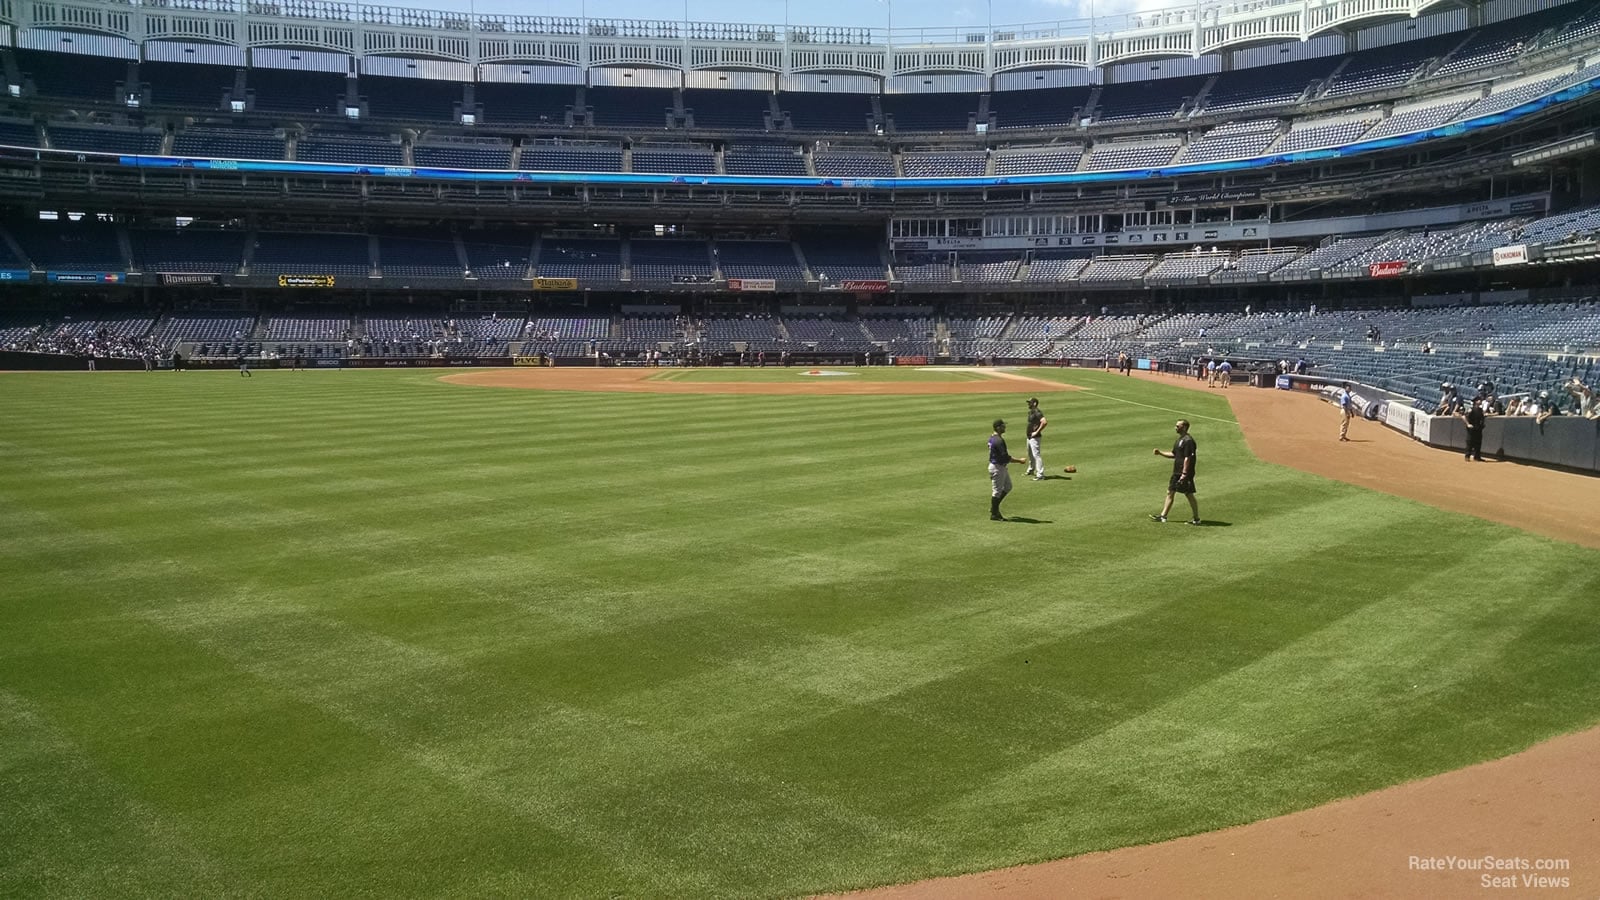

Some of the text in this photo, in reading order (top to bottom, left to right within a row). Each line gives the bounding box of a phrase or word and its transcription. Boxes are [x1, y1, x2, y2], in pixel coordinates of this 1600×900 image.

[1199, 191, 1220, 201] World
[1221, 191, 1256, 200] Champions
[537, 279, 572, 288] Nathan's
[842, 281, 887, 291] Budweiser
